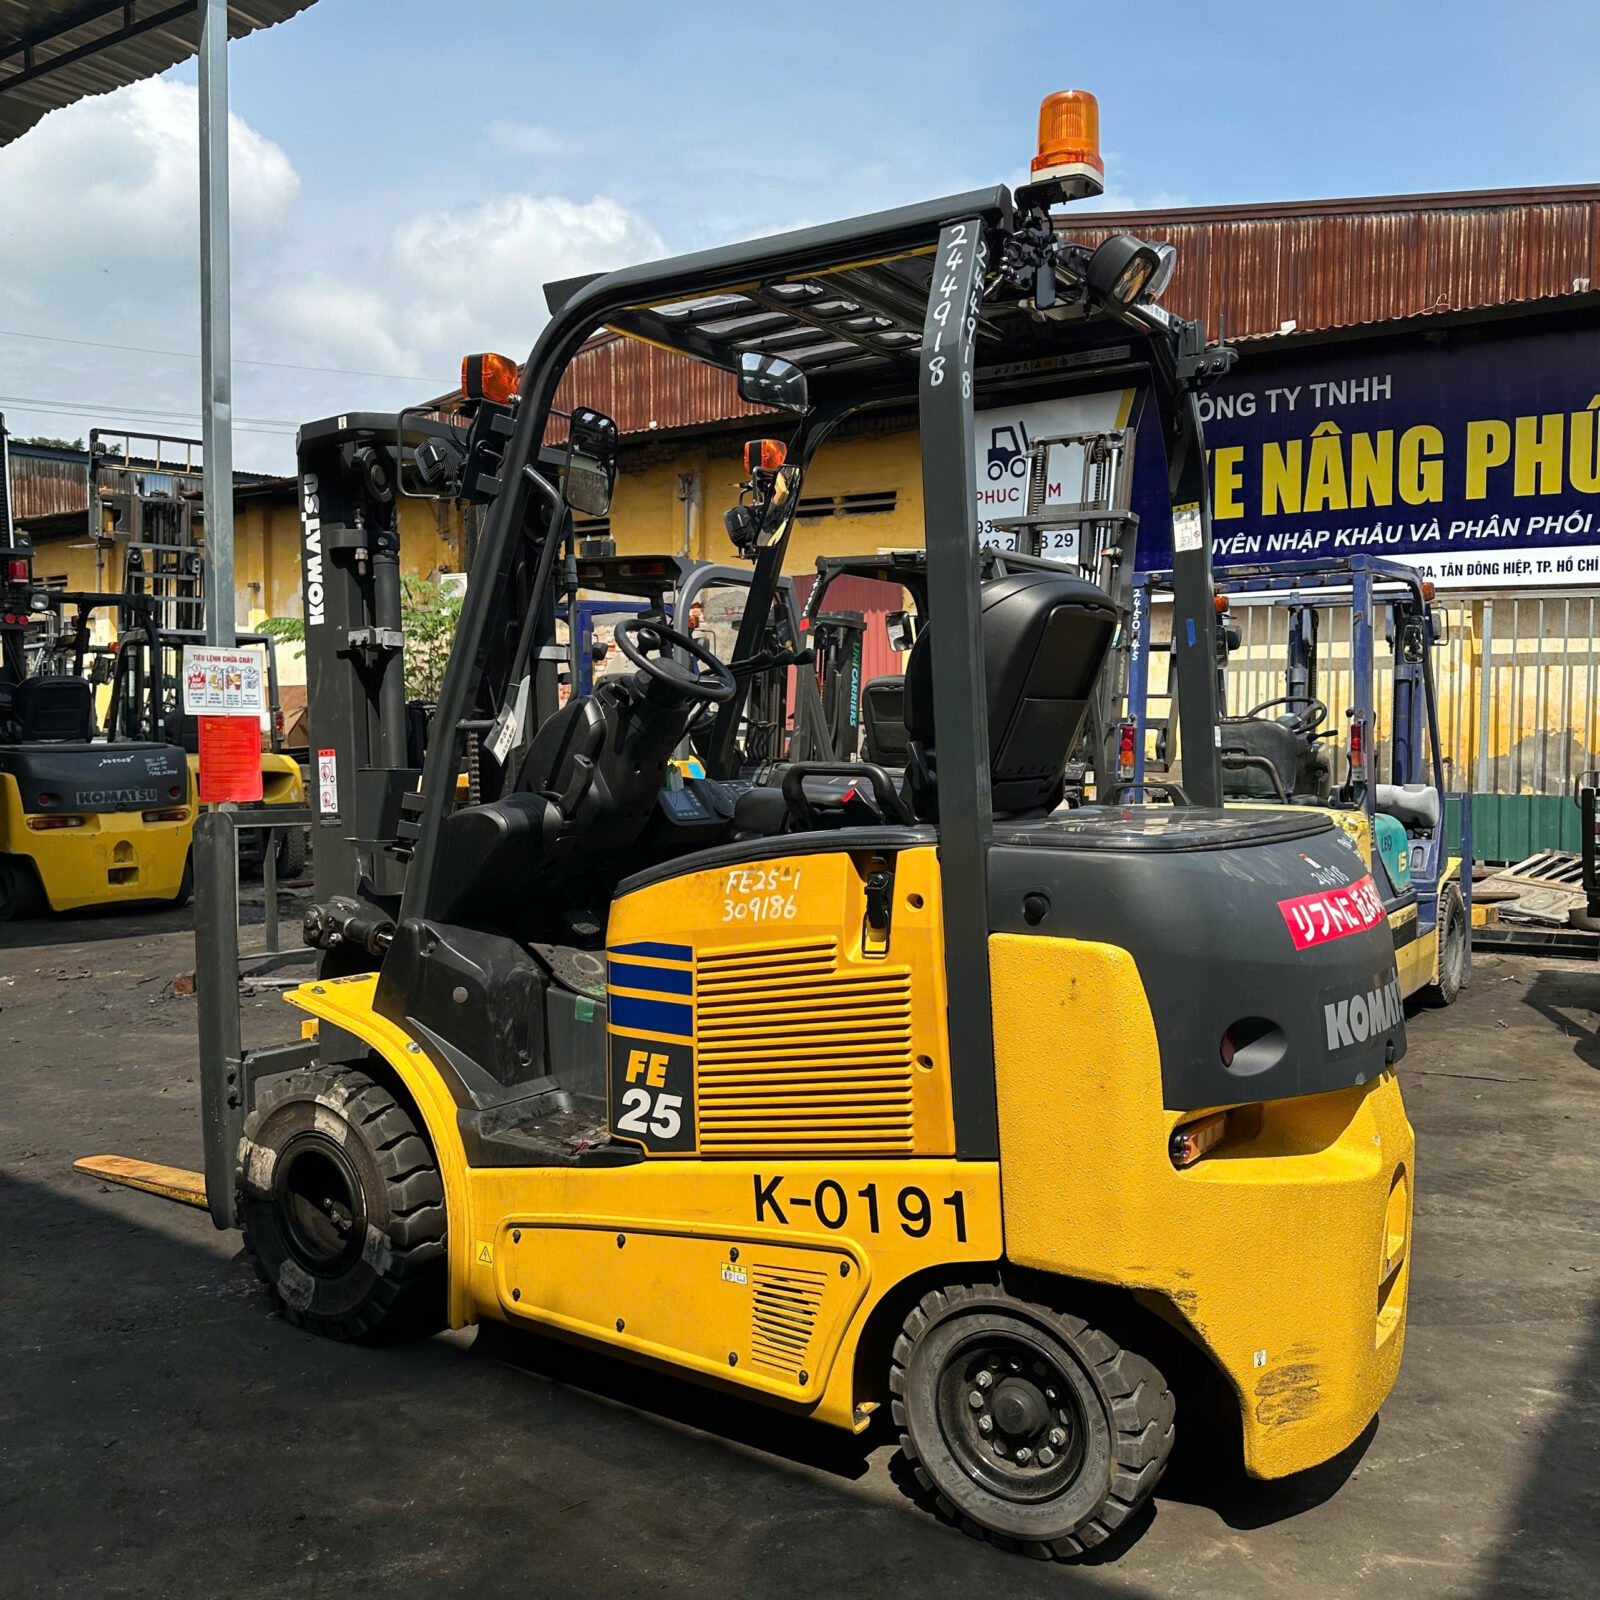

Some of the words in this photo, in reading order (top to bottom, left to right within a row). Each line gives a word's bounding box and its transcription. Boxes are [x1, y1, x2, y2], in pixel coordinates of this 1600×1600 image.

[928, 224, 968, 387] 244918
[961, 240, 987, 400] 244918
[1265, 386, 1302, 413] TY
[1309, 374, 1392, 408] TNHH
[1206, 446, 1245, 520] E
[1261, 420, 1445, 517] NÂNG
[301, 473, 325, 626] KOMATSU
[1054, 533, 1074, 548] 29
[1266, 528, 1330, 553] NHẬP
[1334, 522, 1404, 547] KHẨU
[1410, 518, 1441, 542] VÀ
[1448, 514, 1521, 540] PHÂN
[1526, 510, 1593, 536] PHỐI
[1440, 562, 1463, 577] TÂN
[1467, 560, 1499, 576] ĐÔNG
[1503, 559, 1533, 577] HIỆP,
[1536, 560, 1553, 573] TP.
[1577, 555, 1599, 571] CHÍ
[849, 641, 861, 727] UNICARRIERS
[77, 788, 157, 806] KOMATSU
[725, 870, 801, 895] FE25-1
[721, 895, 798, 922] 309186
[625, 1049, 670, 1089] FE
[617, 1088, 683, 1139] 25
[753, 1174, 967, 1243] K-0191
